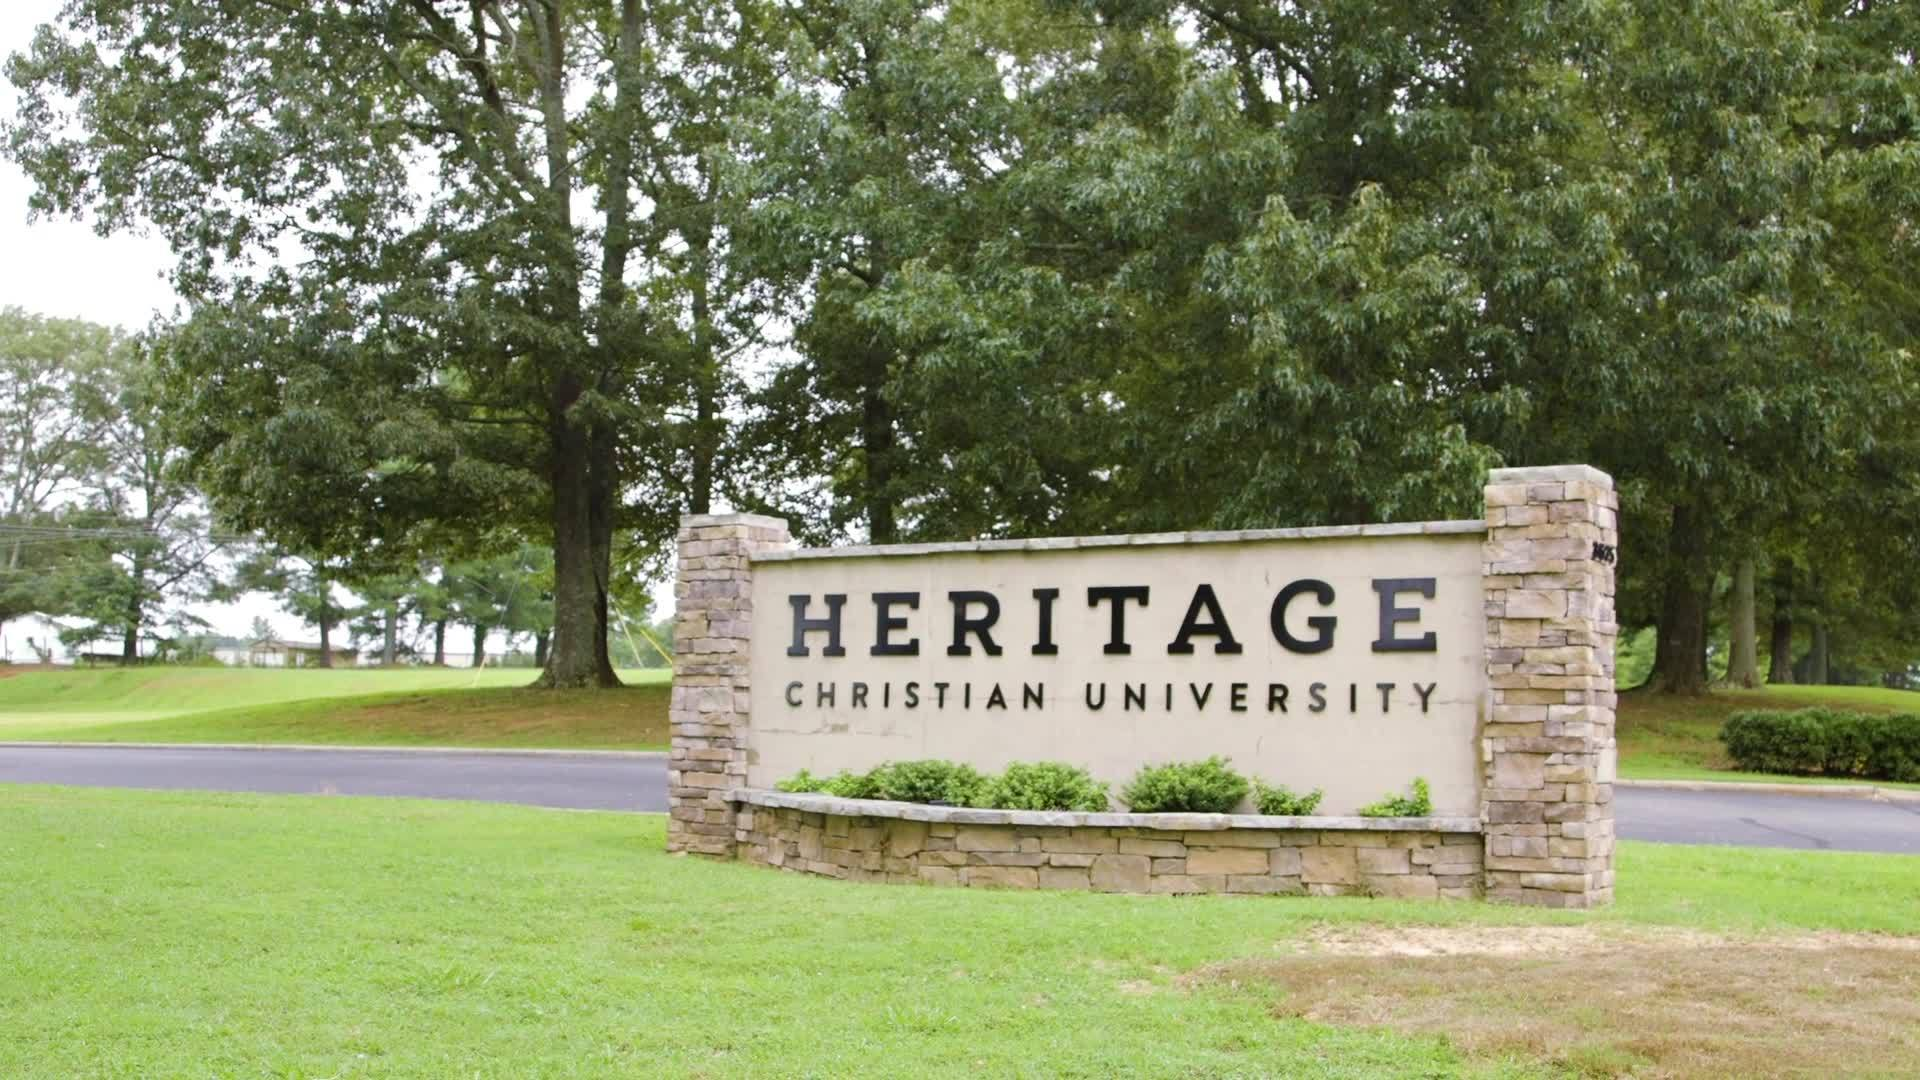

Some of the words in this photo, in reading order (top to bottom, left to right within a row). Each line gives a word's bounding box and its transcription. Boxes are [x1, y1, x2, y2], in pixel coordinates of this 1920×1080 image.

[786, 577, 1438, 658] HERITAGE
[785, 681, 1044, 711] CHRISTIAN
[1085, 681, 1437, 714] UNIVERSITY
